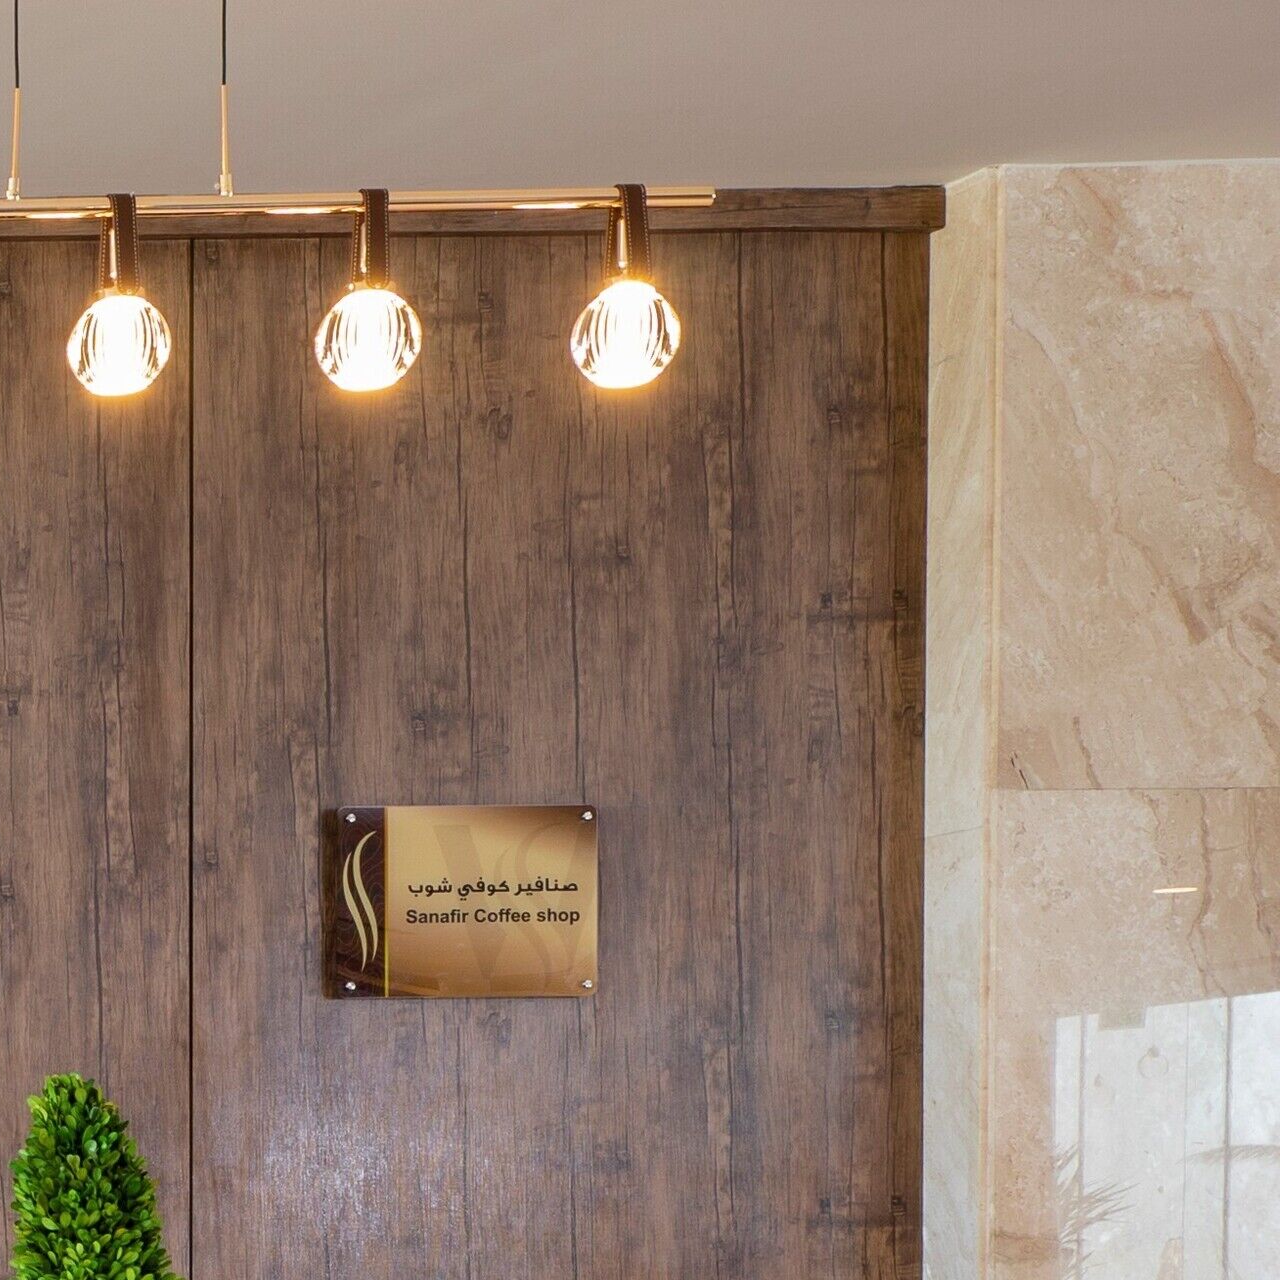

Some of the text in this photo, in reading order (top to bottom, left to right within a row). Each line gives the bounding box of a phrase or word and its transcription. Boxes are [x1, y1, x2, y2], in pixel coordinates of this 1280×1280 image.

[407, 876, 578, 900] صنافير كوفي شوب
[406, 908, 580, 926] Sanafir Coffee shop
